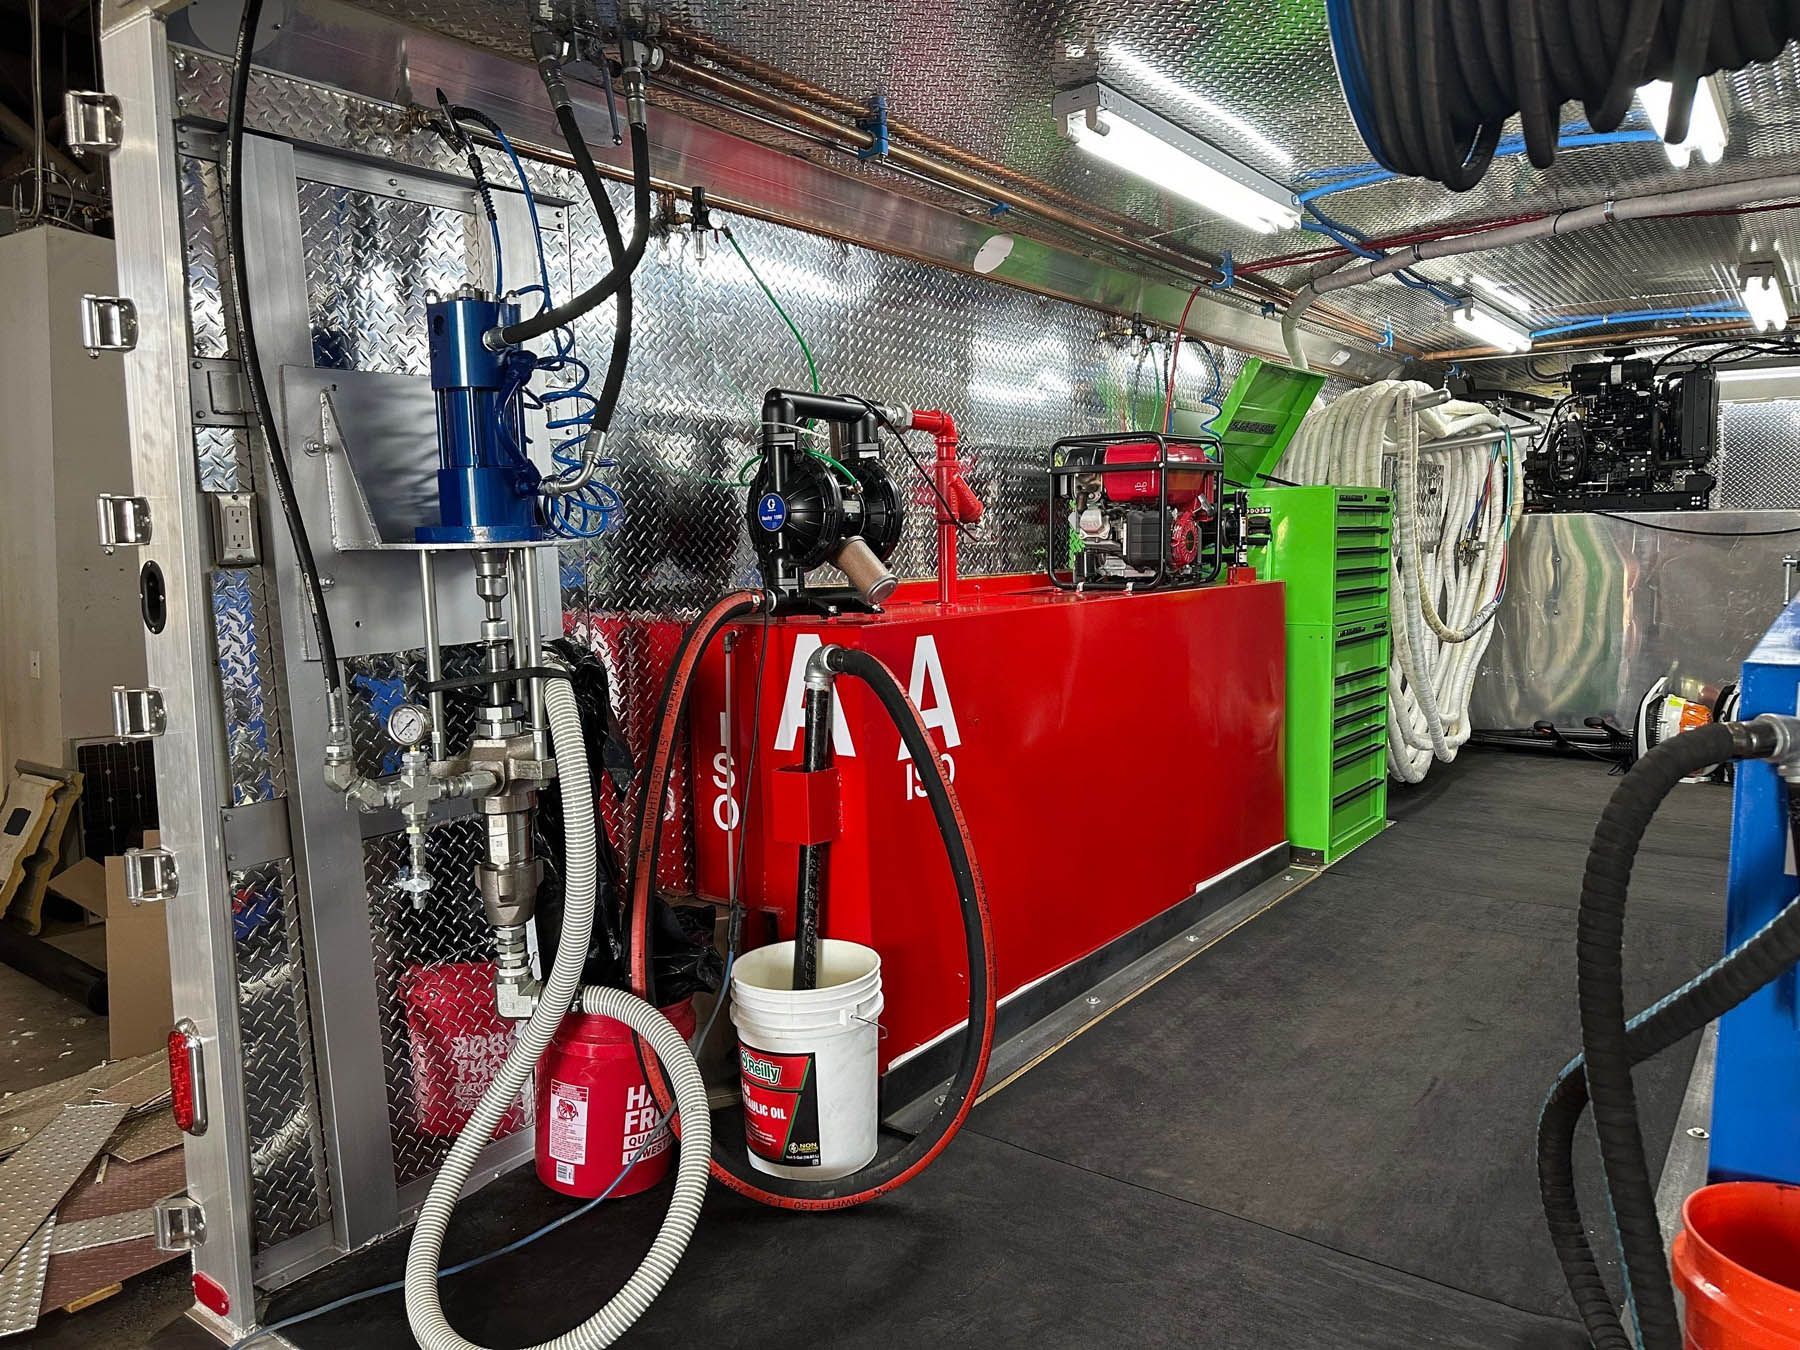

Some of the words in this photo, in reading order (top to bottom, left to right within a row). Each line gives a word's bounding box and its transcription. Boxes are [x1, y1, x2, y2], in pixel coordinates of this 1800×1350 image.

[774, 634, 856, 757] A
[897, 635, 961, 760] A
[770, 1106, 787, 1120] OIL
